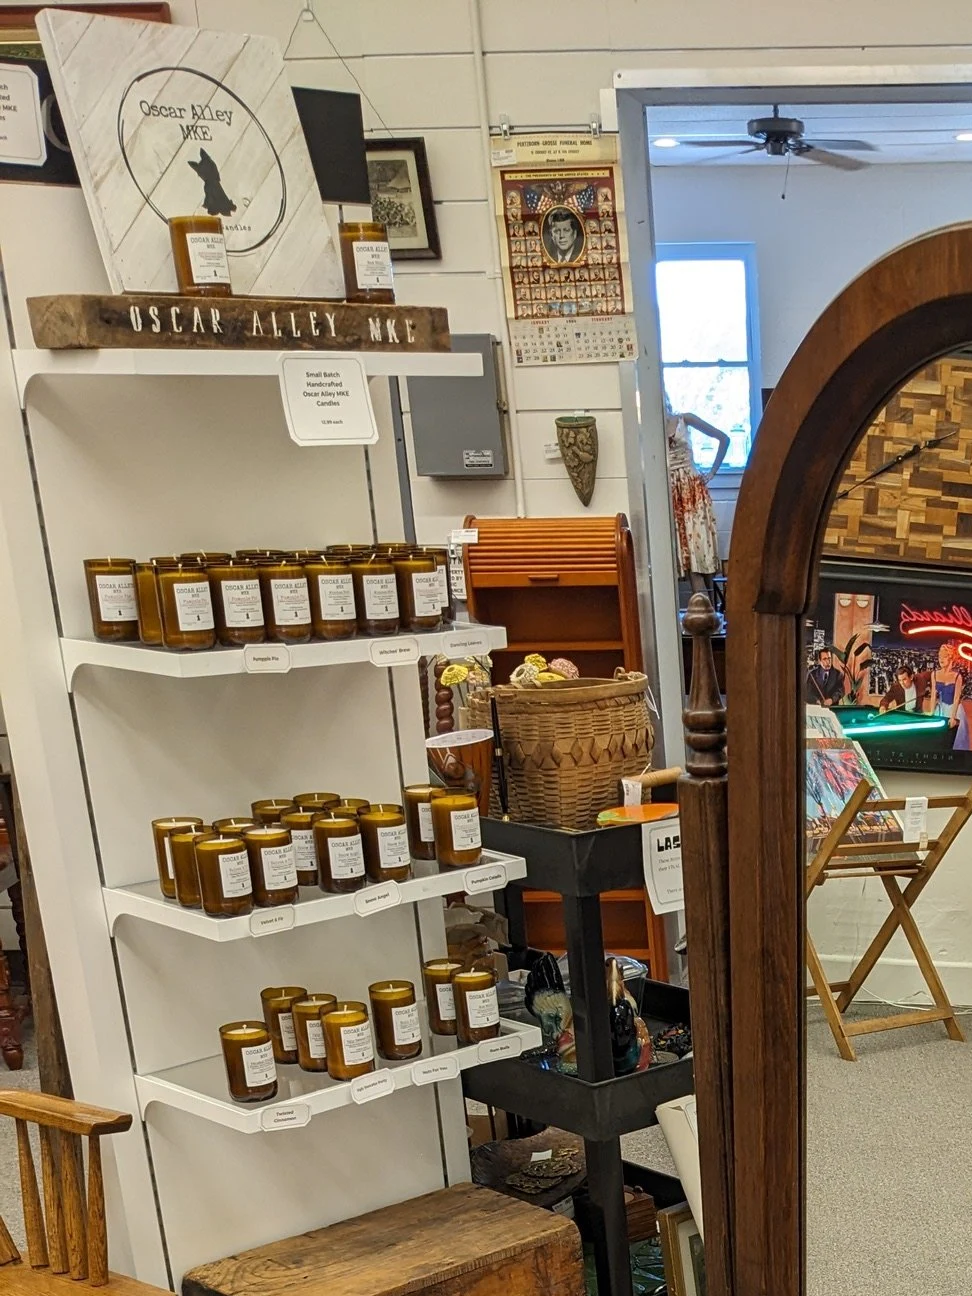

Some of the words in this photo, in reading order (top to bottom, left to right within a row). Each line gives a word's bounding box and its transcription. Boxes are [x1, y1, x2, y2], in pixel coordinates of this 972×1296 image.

[139, 100, 186, 118] Oscar
[191, 104, 233, 126] Alley
[179, 124, 212, 141] MKE
[222, 224, 251, 232] andles
[130, 306, 223, 333] OSCAR
[252, 311, 337, 338] ALLEY
[368, 317, 415, 343] MKE
[657, 835, 681, 853] LAS
[471, 877, 488, 885] Pumpkin
